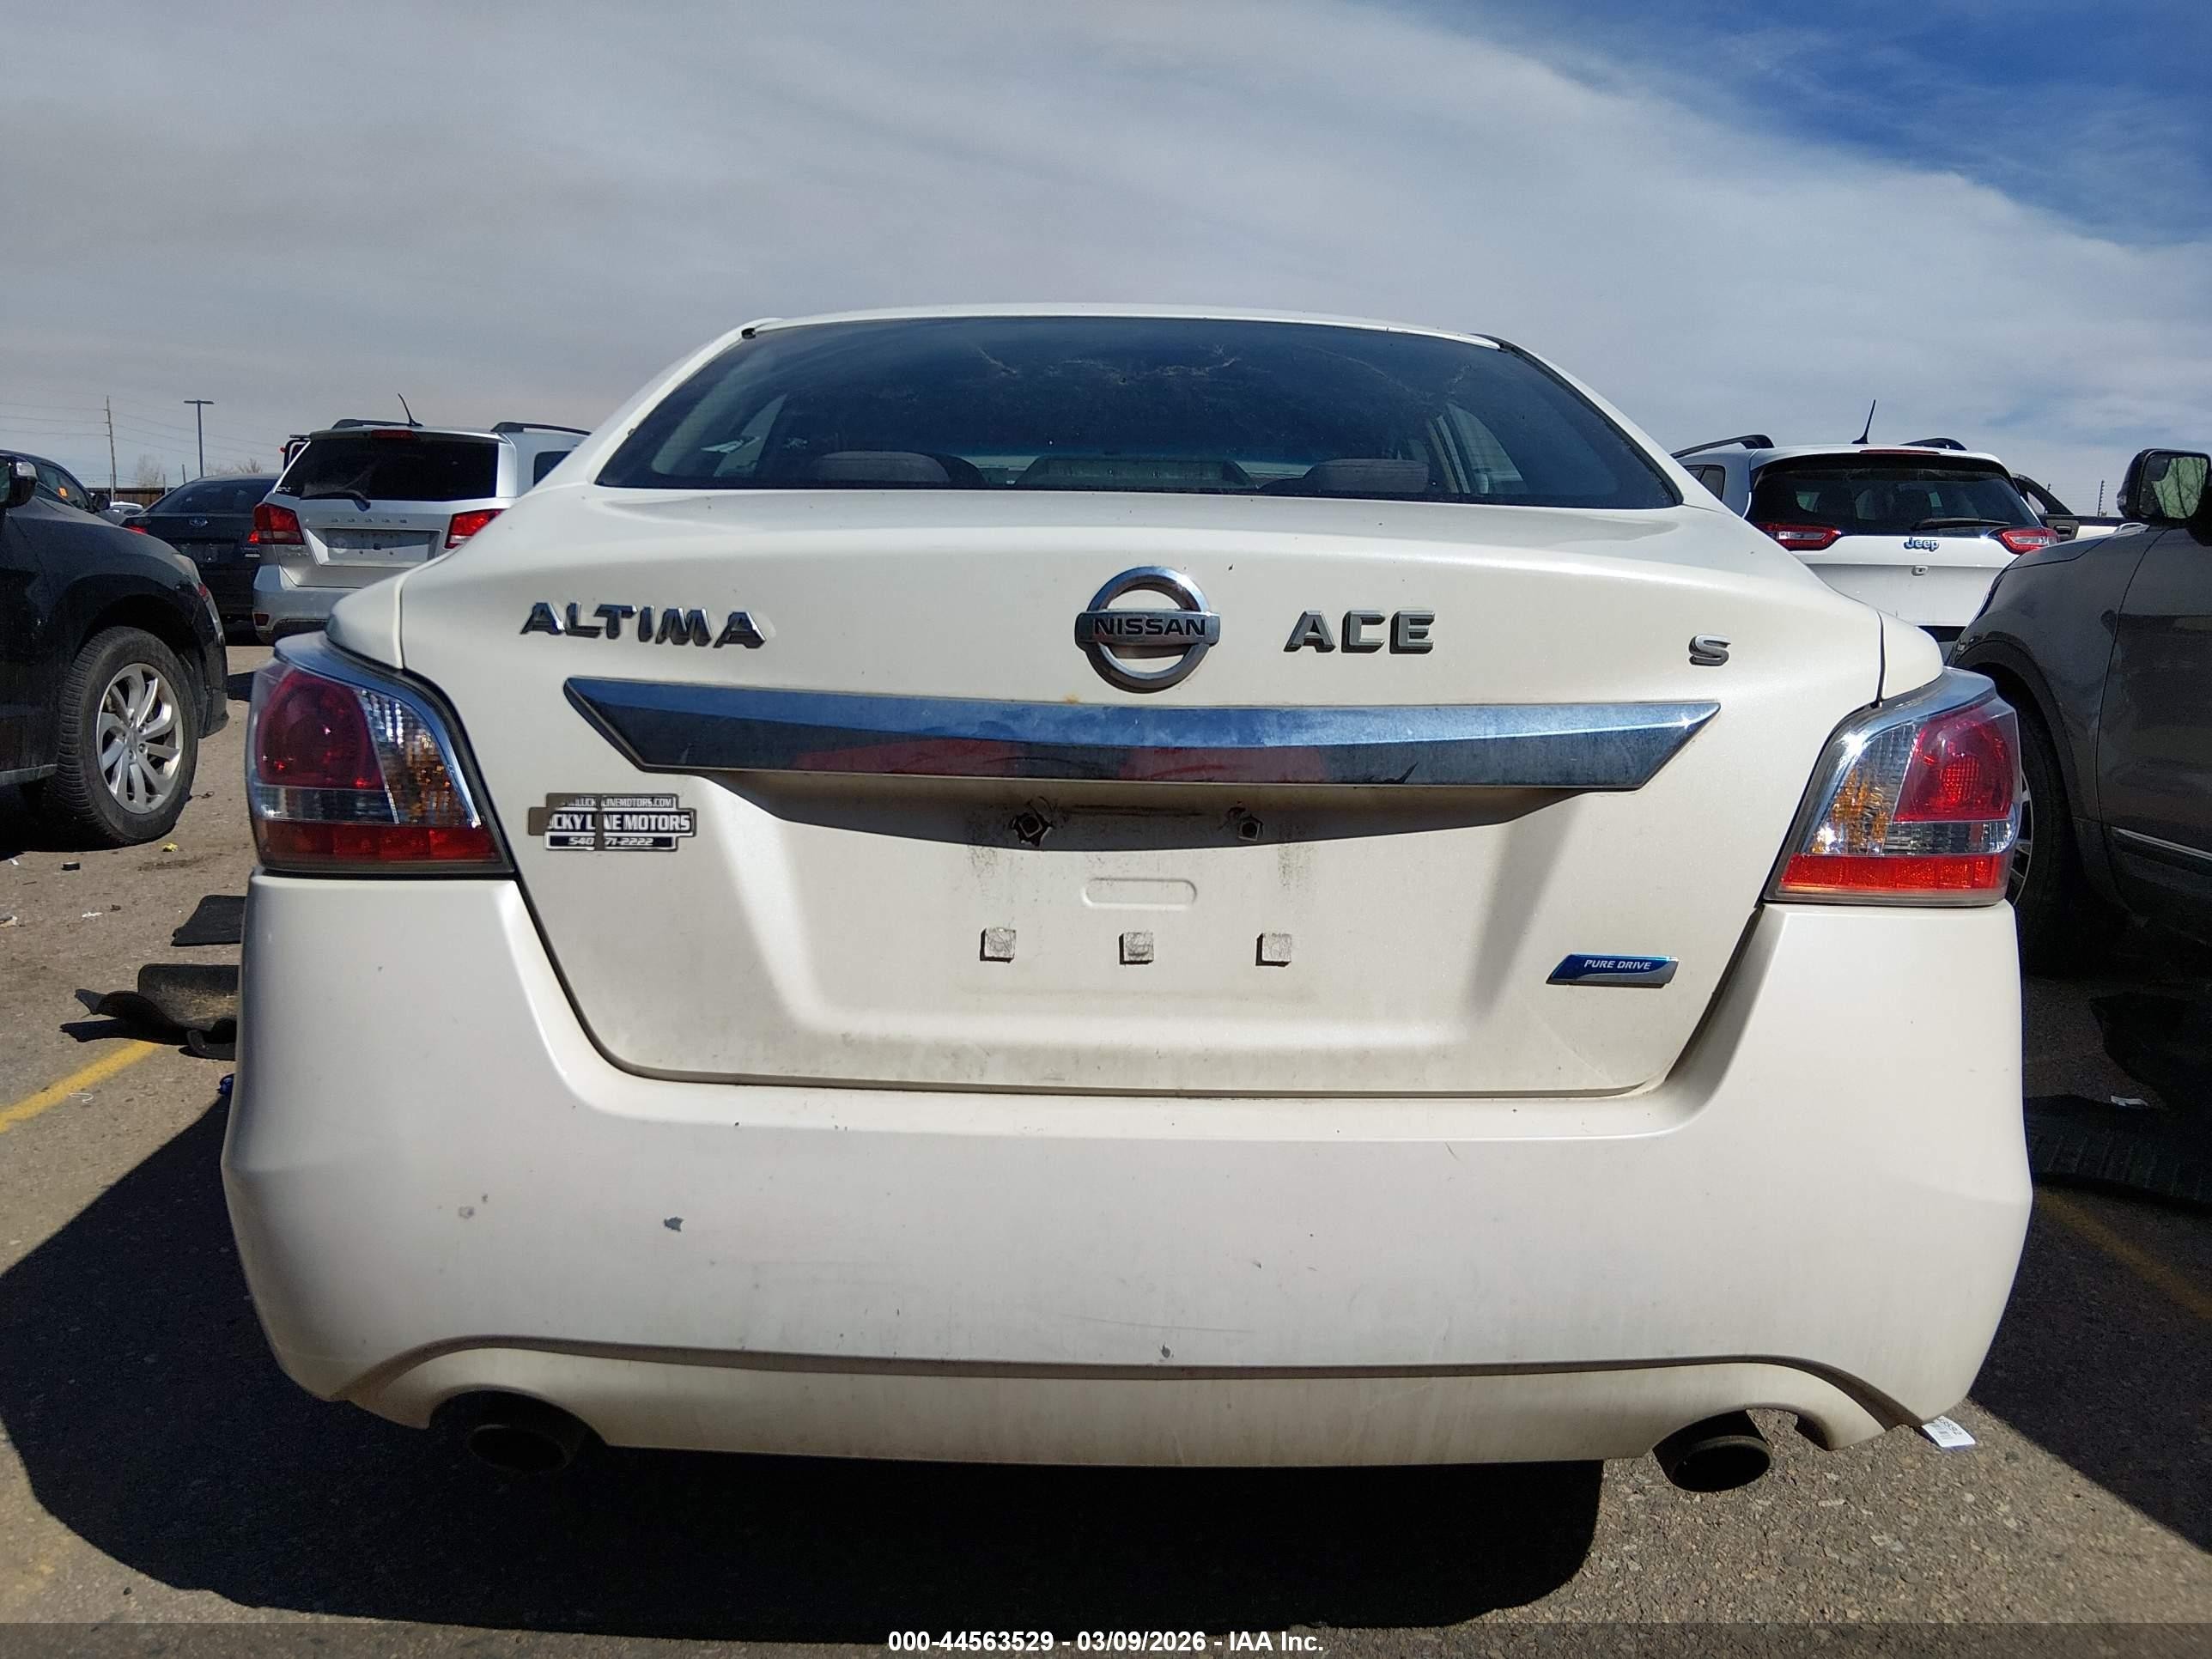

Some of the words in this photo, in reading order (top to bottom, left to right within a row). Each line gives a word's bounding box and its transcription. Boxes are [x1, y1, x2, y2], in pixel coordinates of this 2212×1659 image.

[1904, 537, 1939, 551] Jeep
[520, 602, 767, 648] ALTIMA
[1094, 617, 1206, 636] NISSAN
[1283, 610, 1436, 653] ACE
[1688, 635, 1731, 666] S
[586, 814, 621, 830] LNE
[623, 814, 690, 830] MOTORS
[1584, 959, 1615, 969] PURE
[1617, 961, 1652, 970] DRIVE
